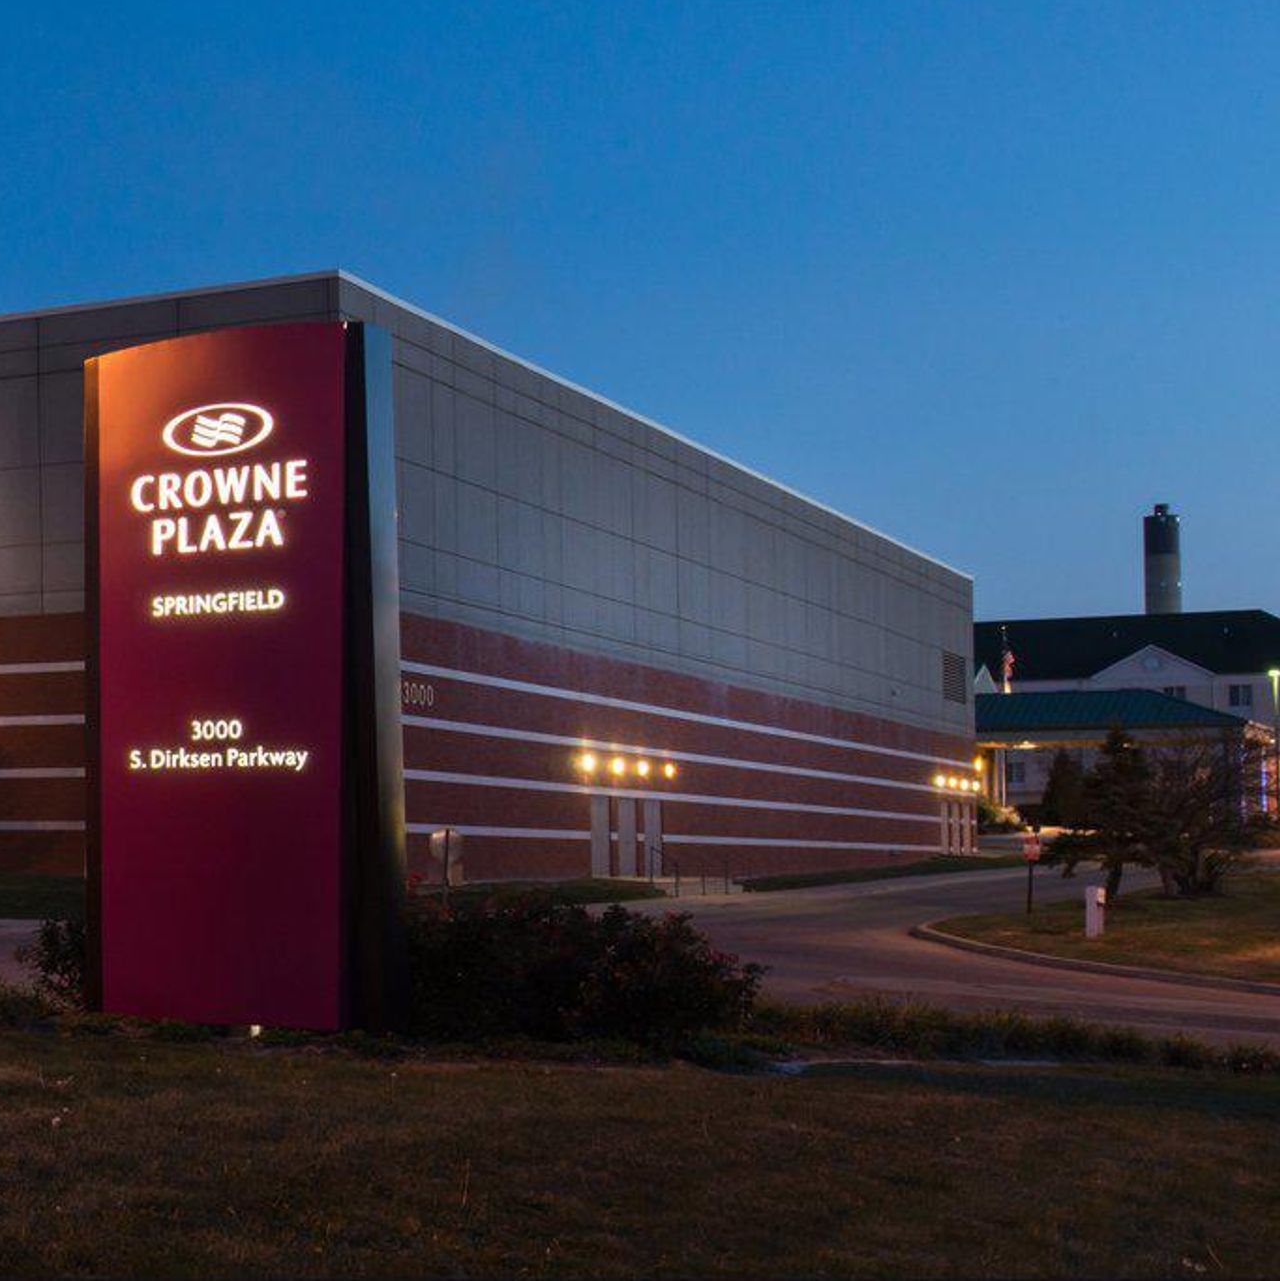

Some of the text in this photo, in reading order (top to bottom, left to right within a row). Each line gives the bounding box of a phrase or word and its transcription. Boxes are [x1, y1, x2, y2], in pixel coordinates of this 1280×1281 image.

[130, 459, 308, 512] CROWNE
[152, 509, 284, 555] PLAZA
[152, 588, 285, 617] SPRINGFIELD
[191, 719, 242, 740] 3000
[130, 745, 308, 771] S. Dirksen Parkway
